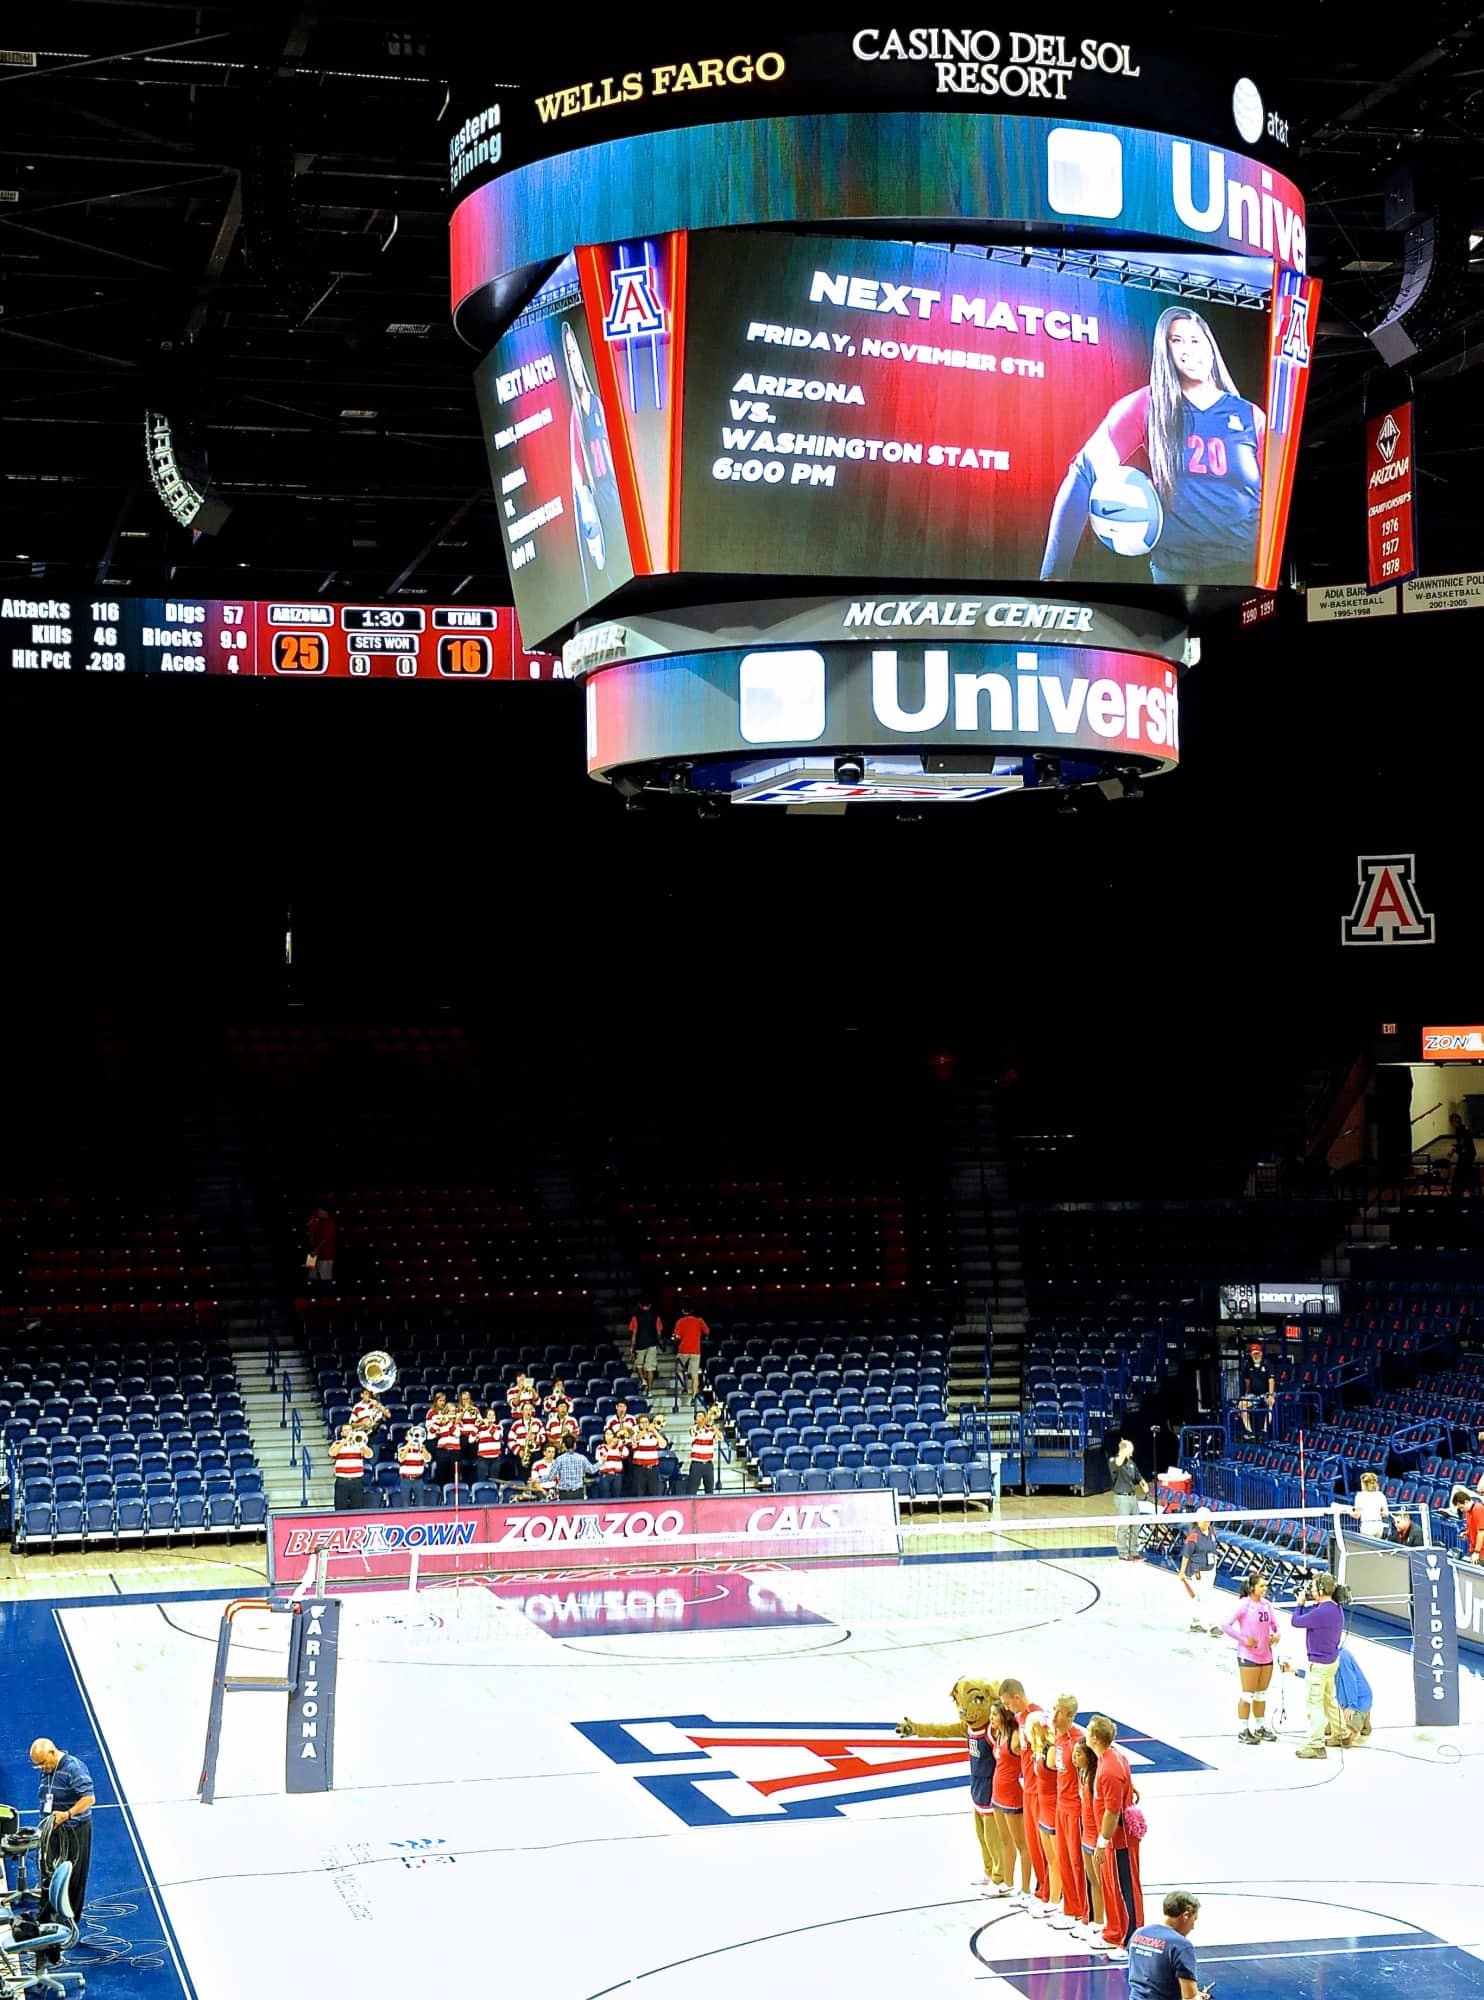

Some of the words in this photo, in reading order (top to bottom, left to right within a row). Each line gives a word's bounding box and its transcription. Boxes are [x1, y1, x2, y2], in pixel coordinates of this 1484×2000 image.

[852, 29, 1000, 62] CASINO
[1009, 32, 1076, 68] DEL
[1080, 39, 1140, 77] SOL
[535, 72, 643, 123] WELLS
[652, 52, 785, 95] FARGO
[935, 62, 1073, 100] RESORT
[1172, 140, 1307, 277] Unive
[809, 270, 940, 321] NEXT
[950, 292, 1100, 346] MATCH
[746, 322, 856, 358] FRIDAY,
[861, 337, 996, 373] NOVEMBER
[1000, 357, 1044, 379] 6TH
[732, 372, 865, 407] ARIZONA
[728, 399, 776, 425] VS.
[721, 427, 922, 465] WASHINGTON
[926, 444, 1010, 471] STATE
[1187, 434, 1228, 477] 20
[710, 457, 784, 483] 6:00
[790, 461, 837, 487] PM
[1368, 456, 1409, 489] ARIZONA
[1381, 517, 1399, 537] 1976
[1382, 537, 1400, 557] 1977
[1382, 557, 1400, 577] 1978
[1325, 589, 1344, 599] ADIA
[1408, 577, 1464, 591] SHAWNTINICE
[1467, 575, 1484, 585] POL
[1416, 588, 1480, 600] W-BASKETBALL
[1, 598, 70, 619] Attacks
[91, 602, 120, 621] 116
[165, 603, 205, 623] Digs
[223, 605, 244, 624] 57
[1320, 597, 1384, 608] W-BASKETBALL
[1429, 599, 1468, 608] 2001-2005
[362, 611, 405, 627] 1:30
[447, 611, 481, 626] UTAH
[843, 601, 982, 628] MCKALE
[984, 603, 1094, 632] CENTER
[31, 624, 72, 644] Kills
[93, 627, 117, 646] 46
[142, 627, 203, 647] Blocks
[355, 636, 381, 649] SETS
[384, 637, 410, 650] WON
[12, 649, 39, 669] Hit
[41, 650, 71, 670] Pct
[85, 652, 126, 671] .293
[161, 653, 205, 672] Aces
[227, 655, 239, 673] 4
[281, 636, 319, 670] 25
[447, 640, 481, 672] 16
[747, 1503, 843, 1534] CATS
[386, 1520, 478, 1550] DOWN
[1258, 1611, 1269, 1623] 20
[1425, 1567, 1445, 1701] WILDCATS
[300, 1619, 321, 1759] ARIZONA
